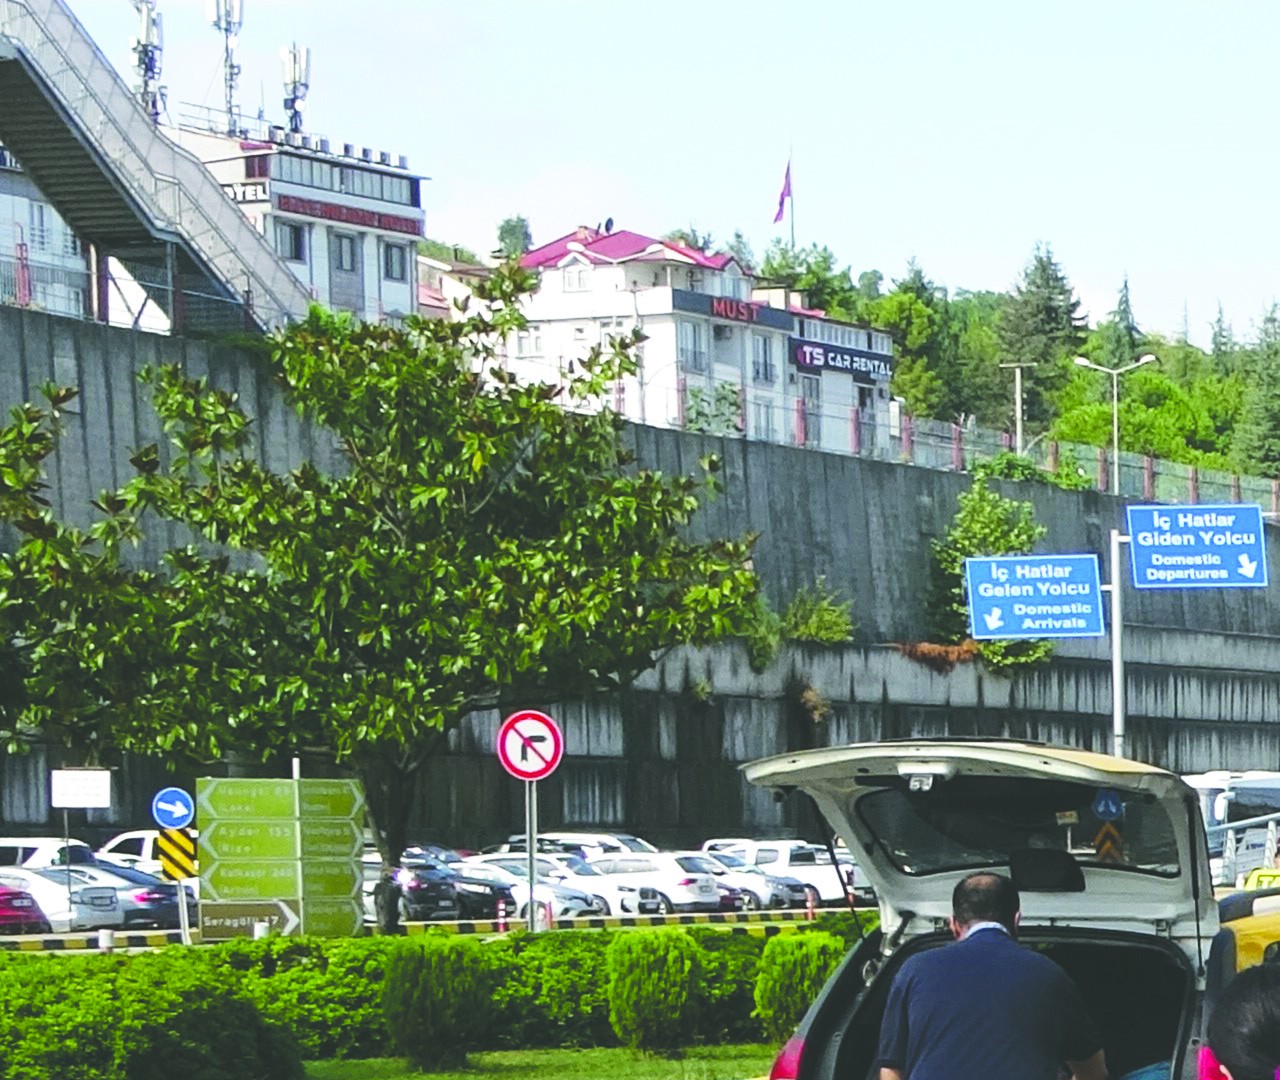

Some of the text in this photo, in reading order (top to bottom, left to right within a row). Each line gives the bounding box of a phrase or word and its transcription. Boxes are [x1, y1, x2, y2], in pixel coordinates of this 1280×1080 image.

[713, 298, 760, 322] MUST
[803, 346, 892, 376] TS CAR RENTAL
[1178, 512, 1236, 527] Hatlar
[1137, 531, 1256, 546] Giden Yolcu
[1152, 554, 1221, 565] Domestic
[1016, 564, 1072, 579] Hatlar
[1146, 568, 1229, 582] Departures
[978, 582, 1090, 597] Gelen Yolcu
[1013, 602, 1092, 615] Domestic
[1022, 618, 1087, 629] Arrivals
